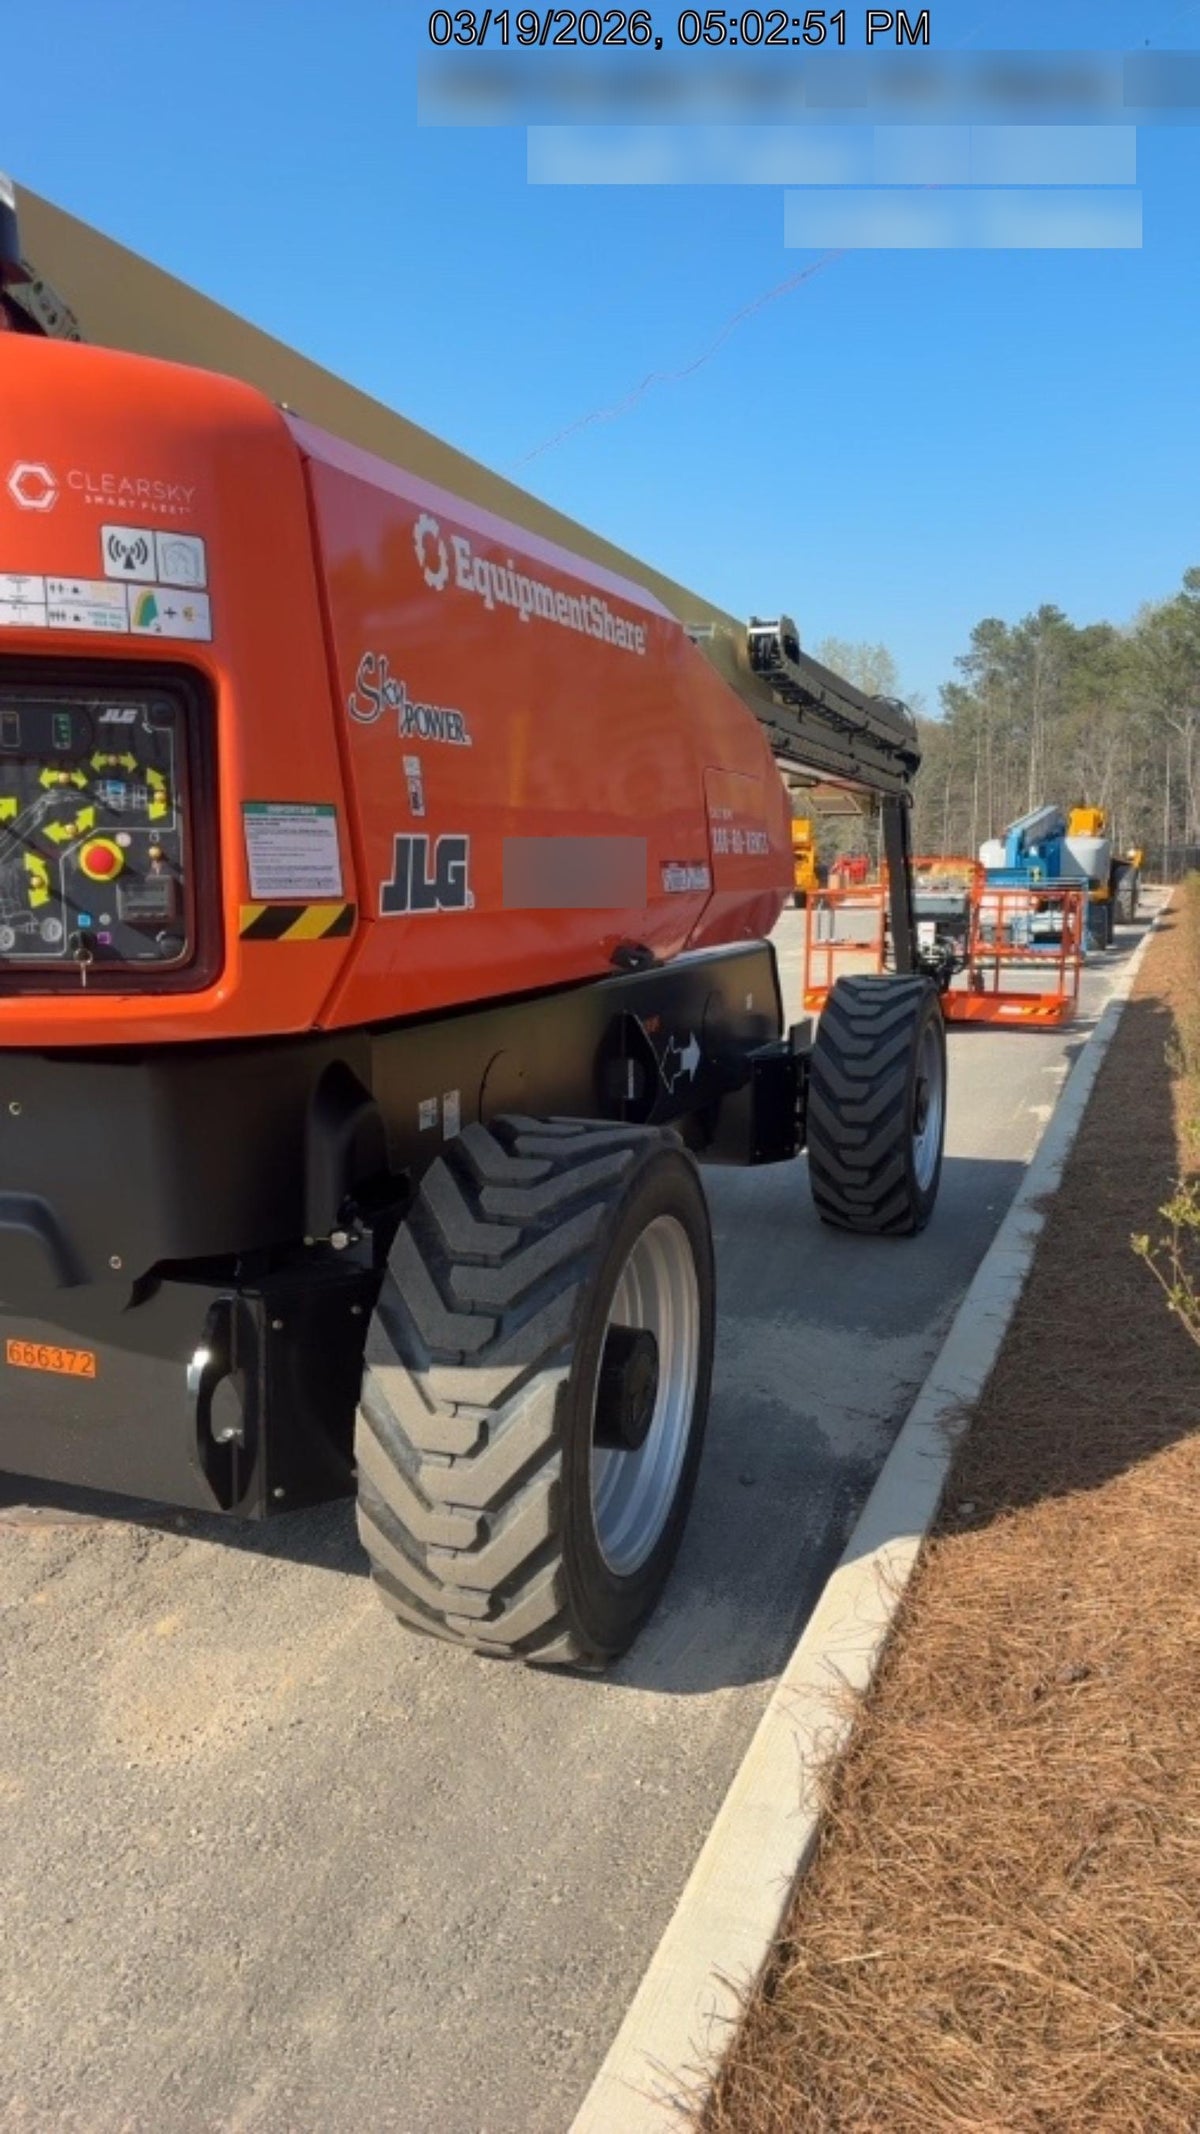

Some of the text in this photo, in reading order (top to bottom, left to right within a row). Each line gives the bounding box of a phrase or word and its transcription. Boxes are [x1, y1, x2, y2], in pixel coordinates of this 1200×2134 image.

[67, 471, 196, 503] CLEARSKY
[85, 494, 135, 509] SMART
[451, 535, 646, 655] EquipmentShare
[98, 708, 138, 724] JLG
[380, 834, 470, 917] JLG
[9, 1341, 94, 1374] 666372
